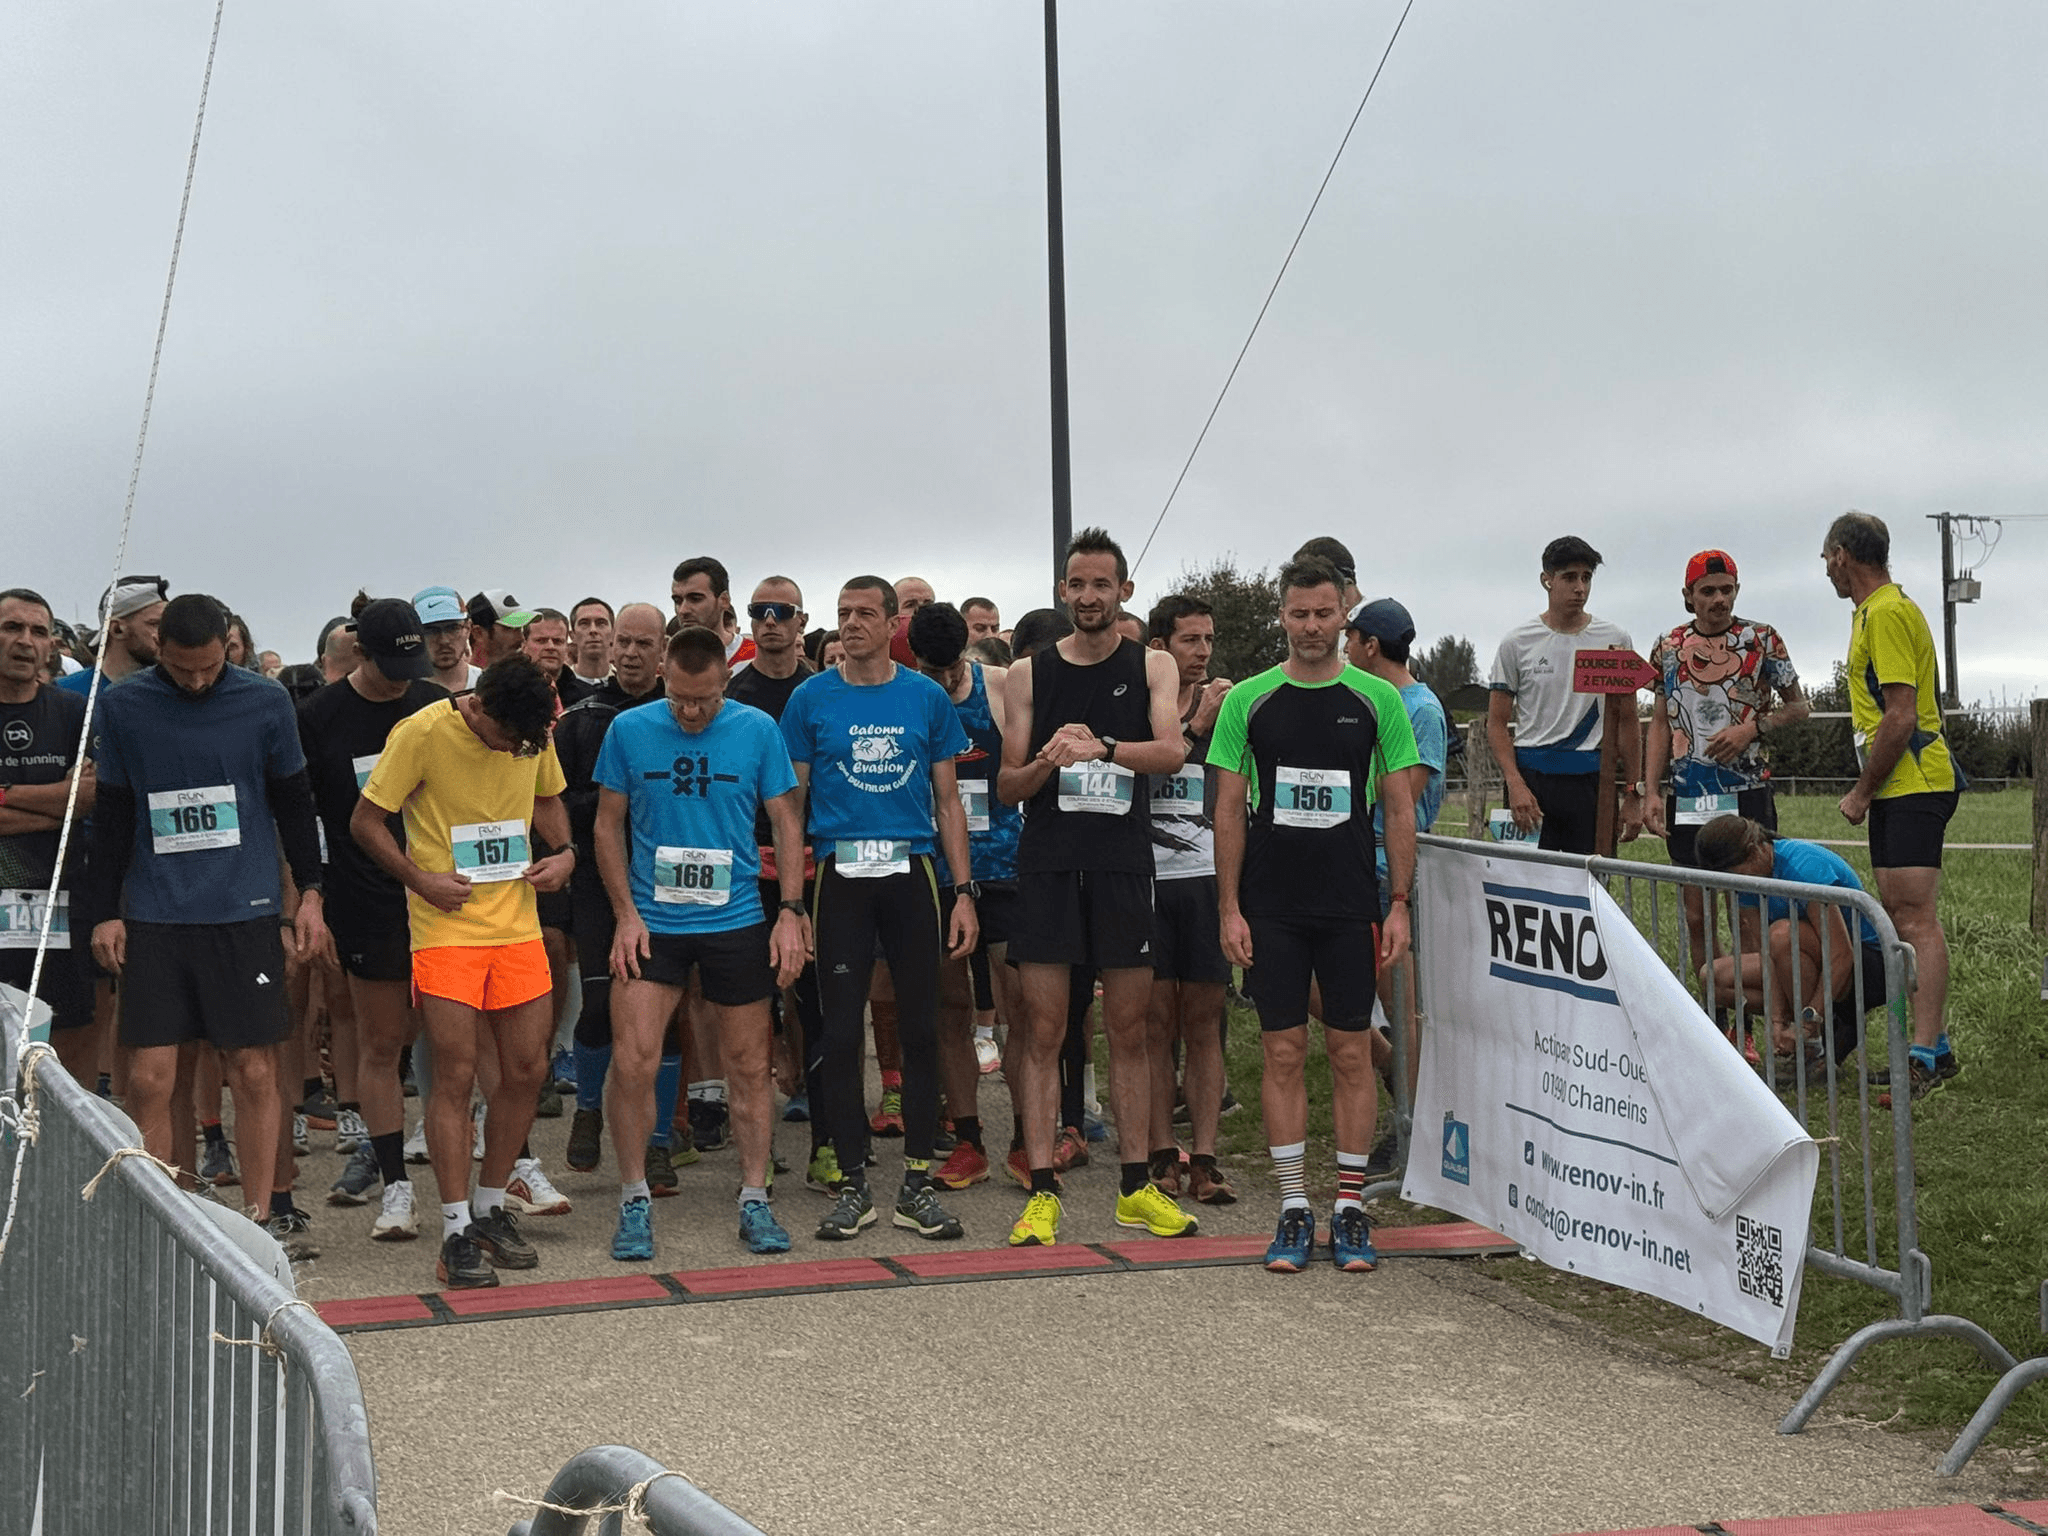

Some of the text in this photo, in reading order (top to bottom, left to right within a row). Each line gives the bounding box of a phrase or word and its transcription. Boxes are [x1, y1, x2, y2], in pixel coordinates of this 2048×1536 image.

[1575, 658, 1642, 671] COURSE DES
[1583, 675, 1635, 688] 2 ETANGS
[849, 723, 905, 736] Calonne
[5, 756, 19, 767] de
[21, 753, 67, 767] running
[852, 760, 904, 774] Evasion
[1078, 773, 1117, 797] 144
[1300, 770, 1325, 781] RUN
[1154, 776, 1189, 800] 63
[1290, 785, 1333, 811] 156
[169, 804, 218, 834] 166
[473, 837, 510, 866] 157
[853, 839, 894, 862] 149
[672, 863, 715, 889] 168
[1485, 898, 1608, 981] RENO
[1568, 1084, 1648, 1125] Chaneins
